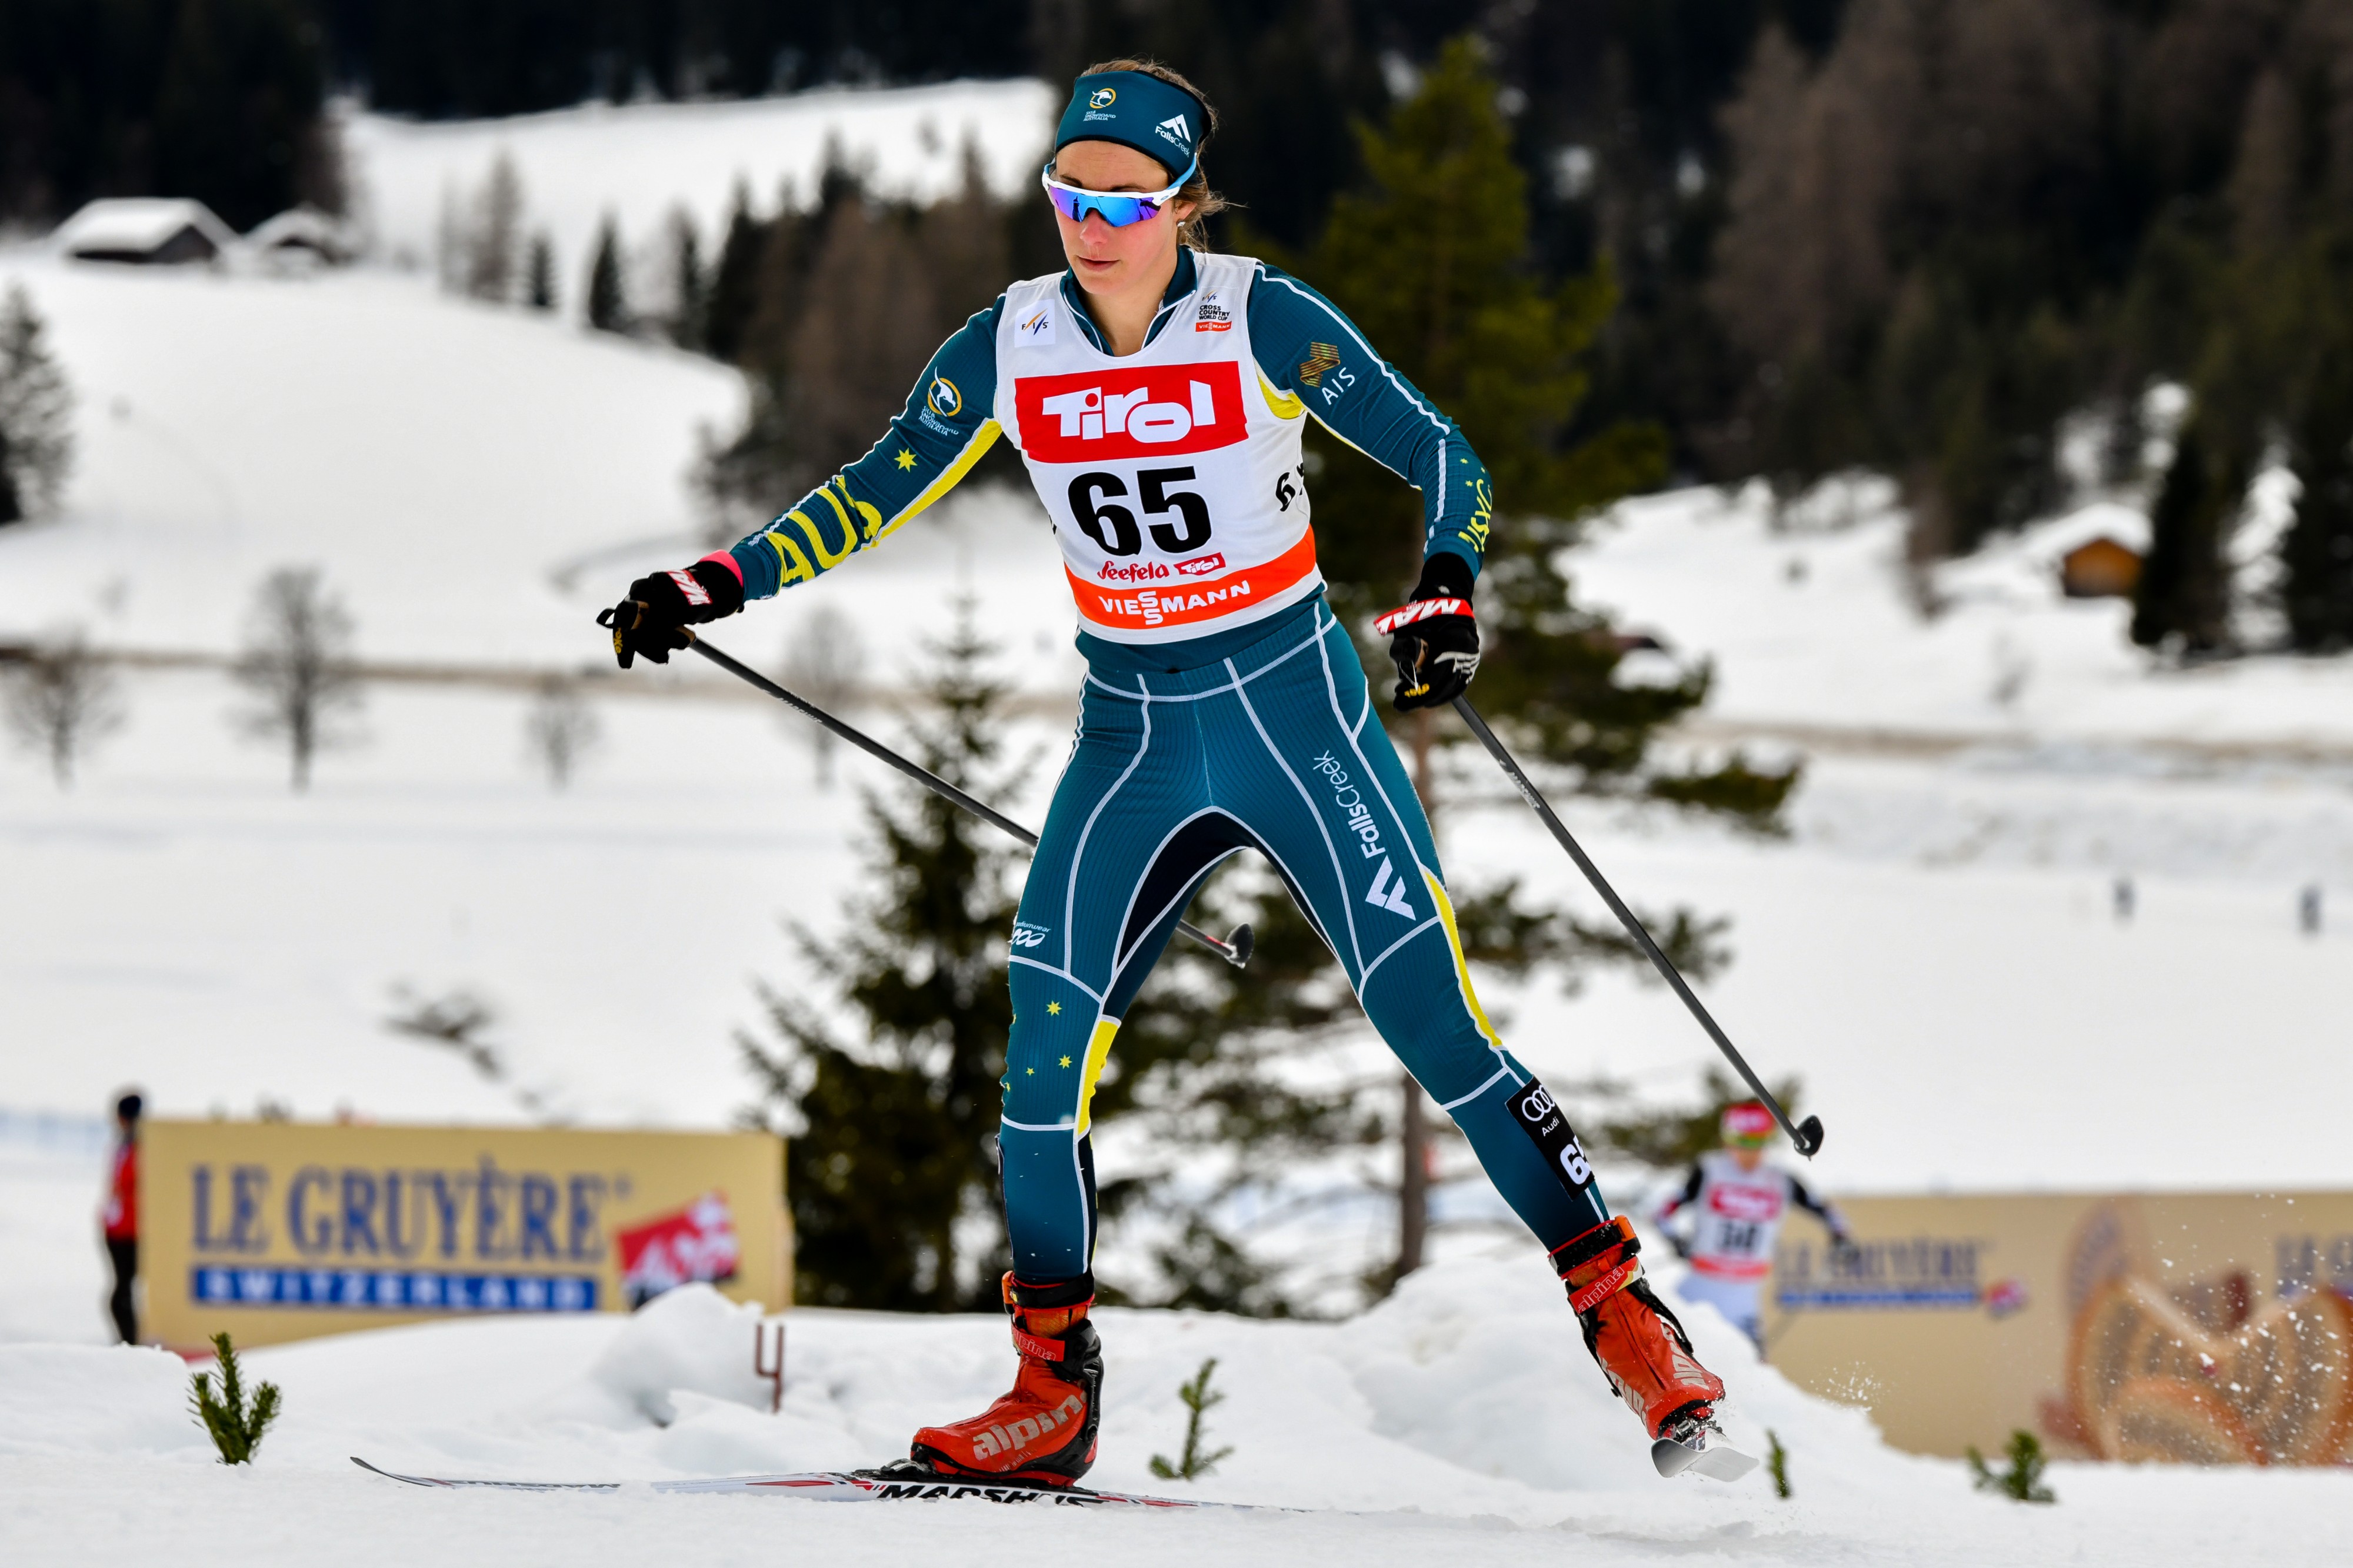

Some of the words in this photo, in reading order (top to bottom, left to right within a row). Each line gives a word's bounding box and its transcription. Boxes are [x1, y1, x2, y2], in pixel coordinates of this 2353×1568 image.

[1155, 125, 1190, 158] FallsCreek
[1321, 366, 1355, 406] AIS
[918, 416, 948, 436] AUSTRALIA
[1042, 379, 1217, 443] Tirol
[1068, 465, 1212, 556] 65
[1313, 749, 1386, 859] FallsCreek
[1542, 1116, 1560, 1137] Audi
[191, 1163, 268, 1254] LE
[288, 1154, 604, 1263] GRUYÈRE
[1578, 1266, 1625, 1313] alpina
